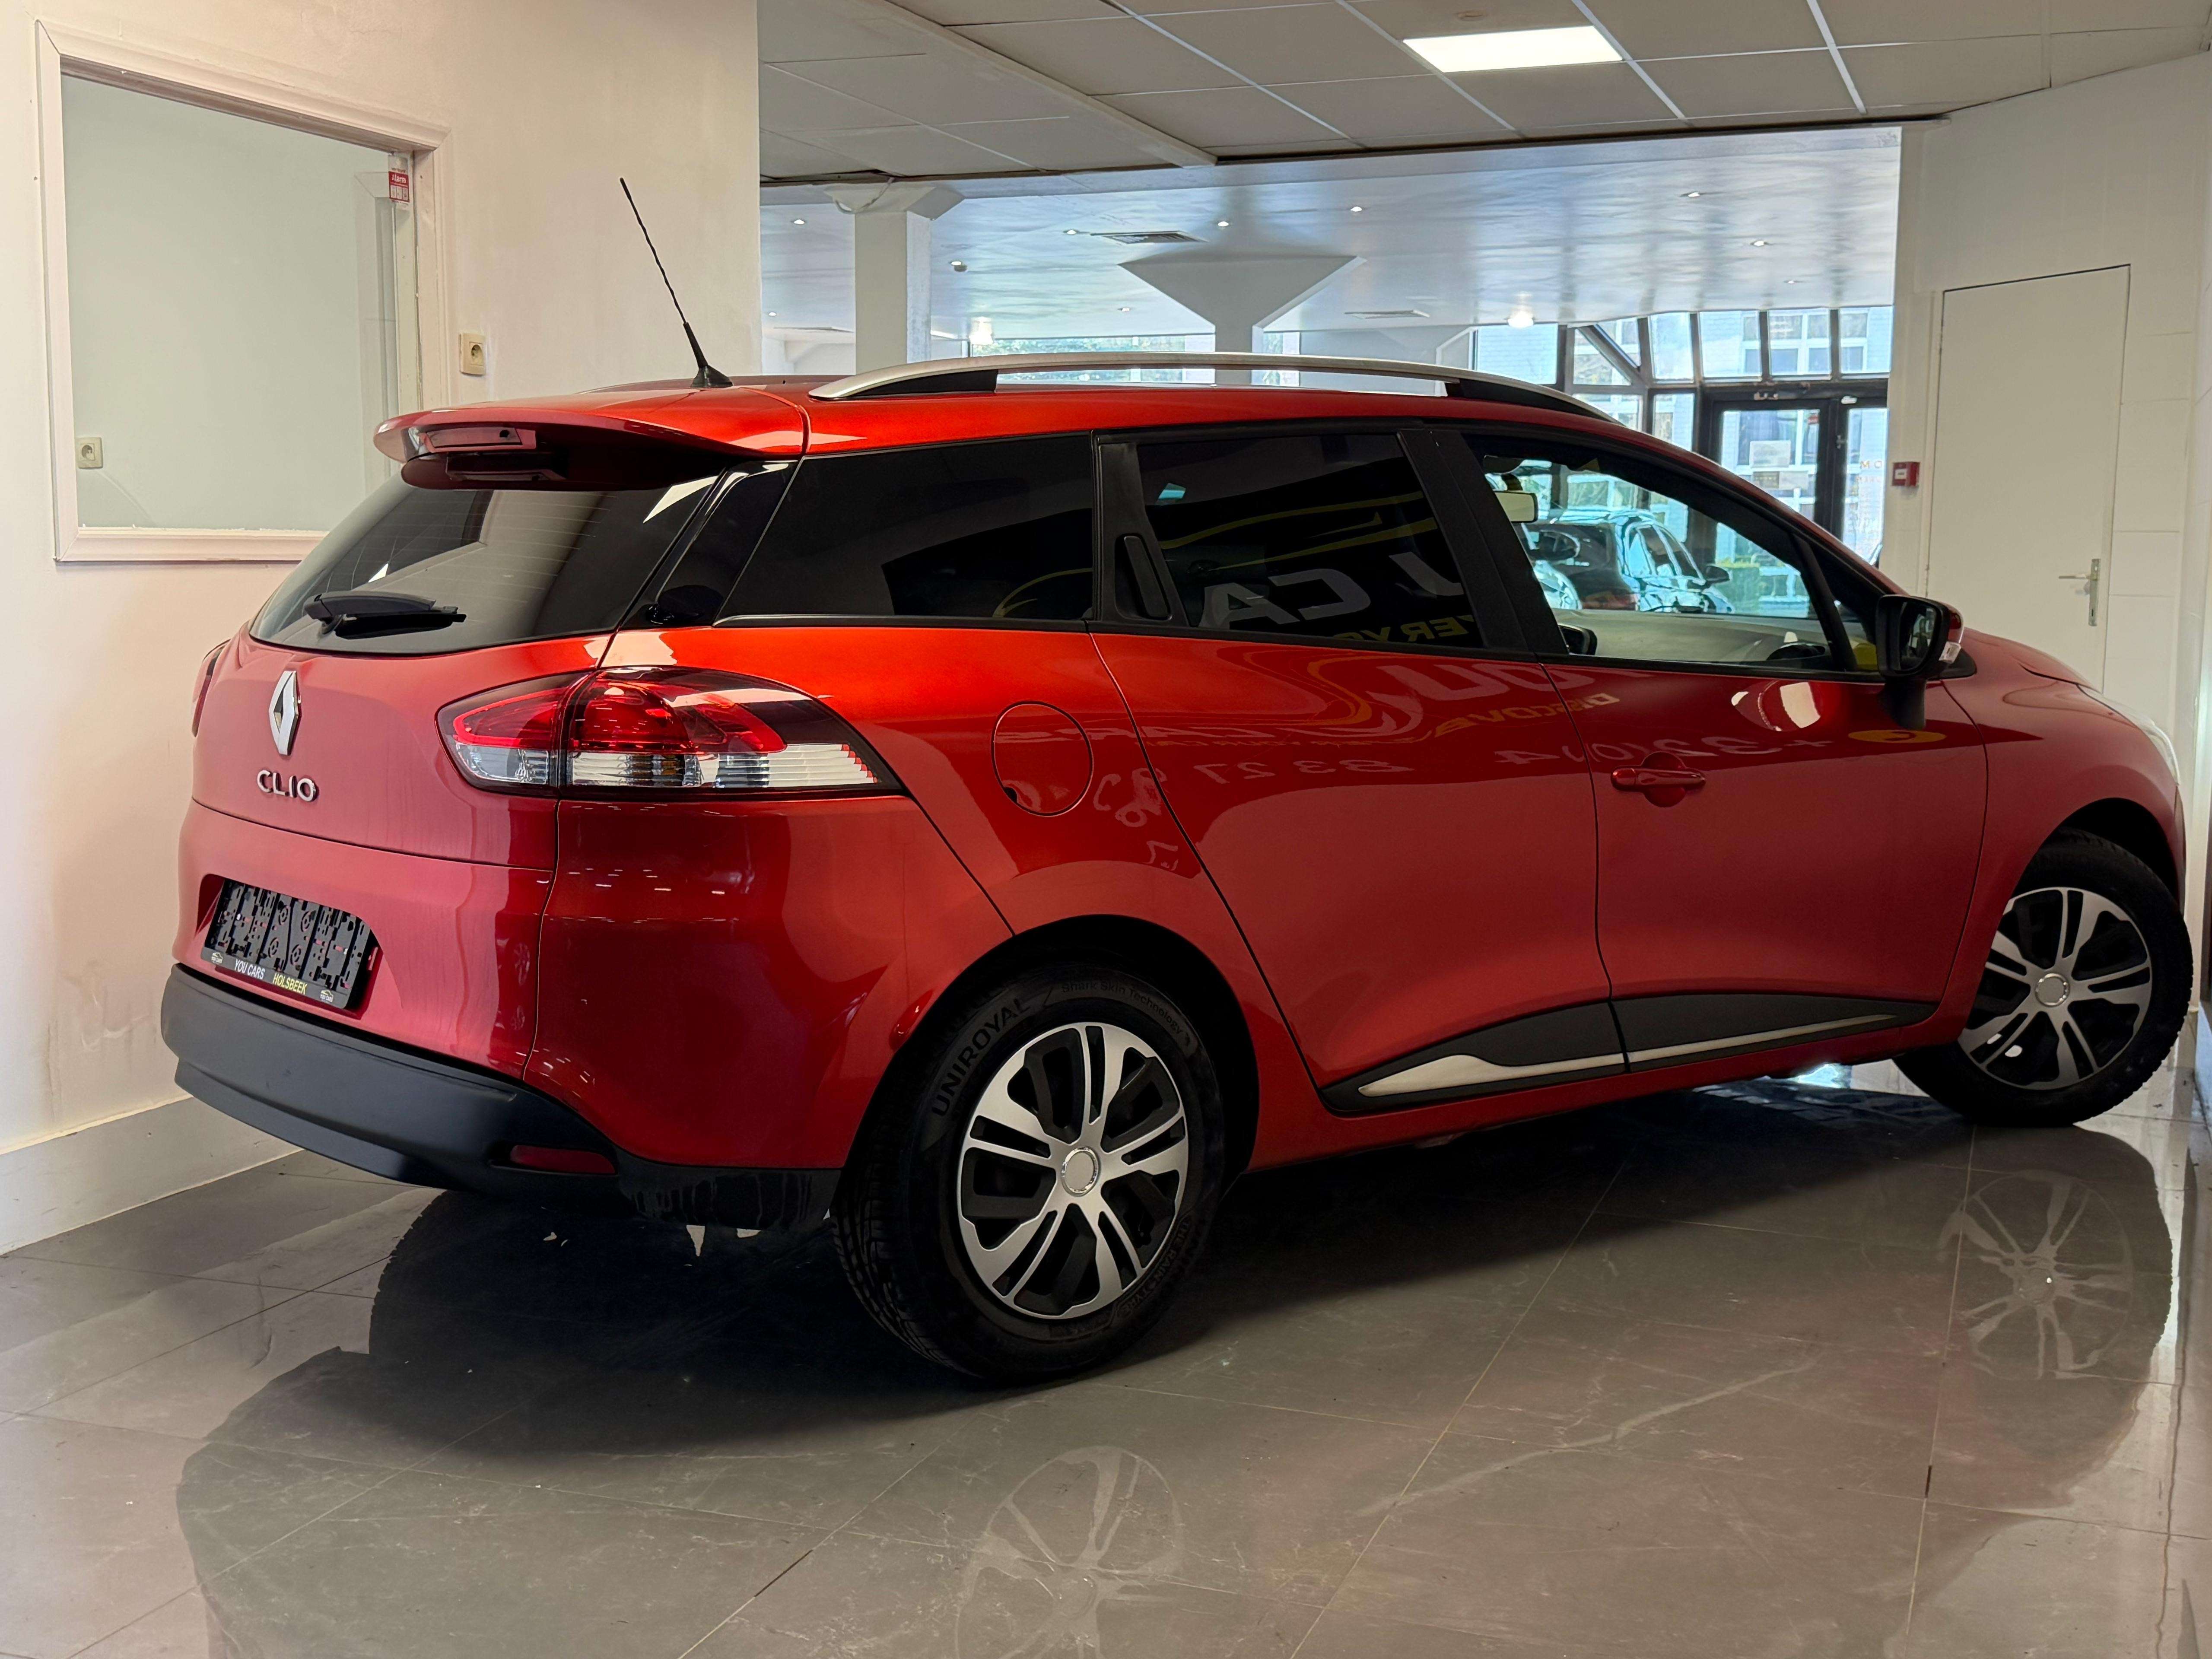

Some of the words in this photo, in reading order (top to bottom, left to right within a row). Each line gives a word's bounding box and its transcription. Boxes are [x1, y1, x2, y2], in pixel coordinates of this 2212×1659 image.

[257, 769, 319, 802] CLIO
[235, 958, 248, 973] YOU
[247, 964, 265, 979] CARS
[272, 973, 308, 995] HOLSBEEK
[1100, 981, 1126, 995] Skin
[1129, 988, 1184, 1036] Technology
[931, 998, 1032, 1116] UNIROYAL
